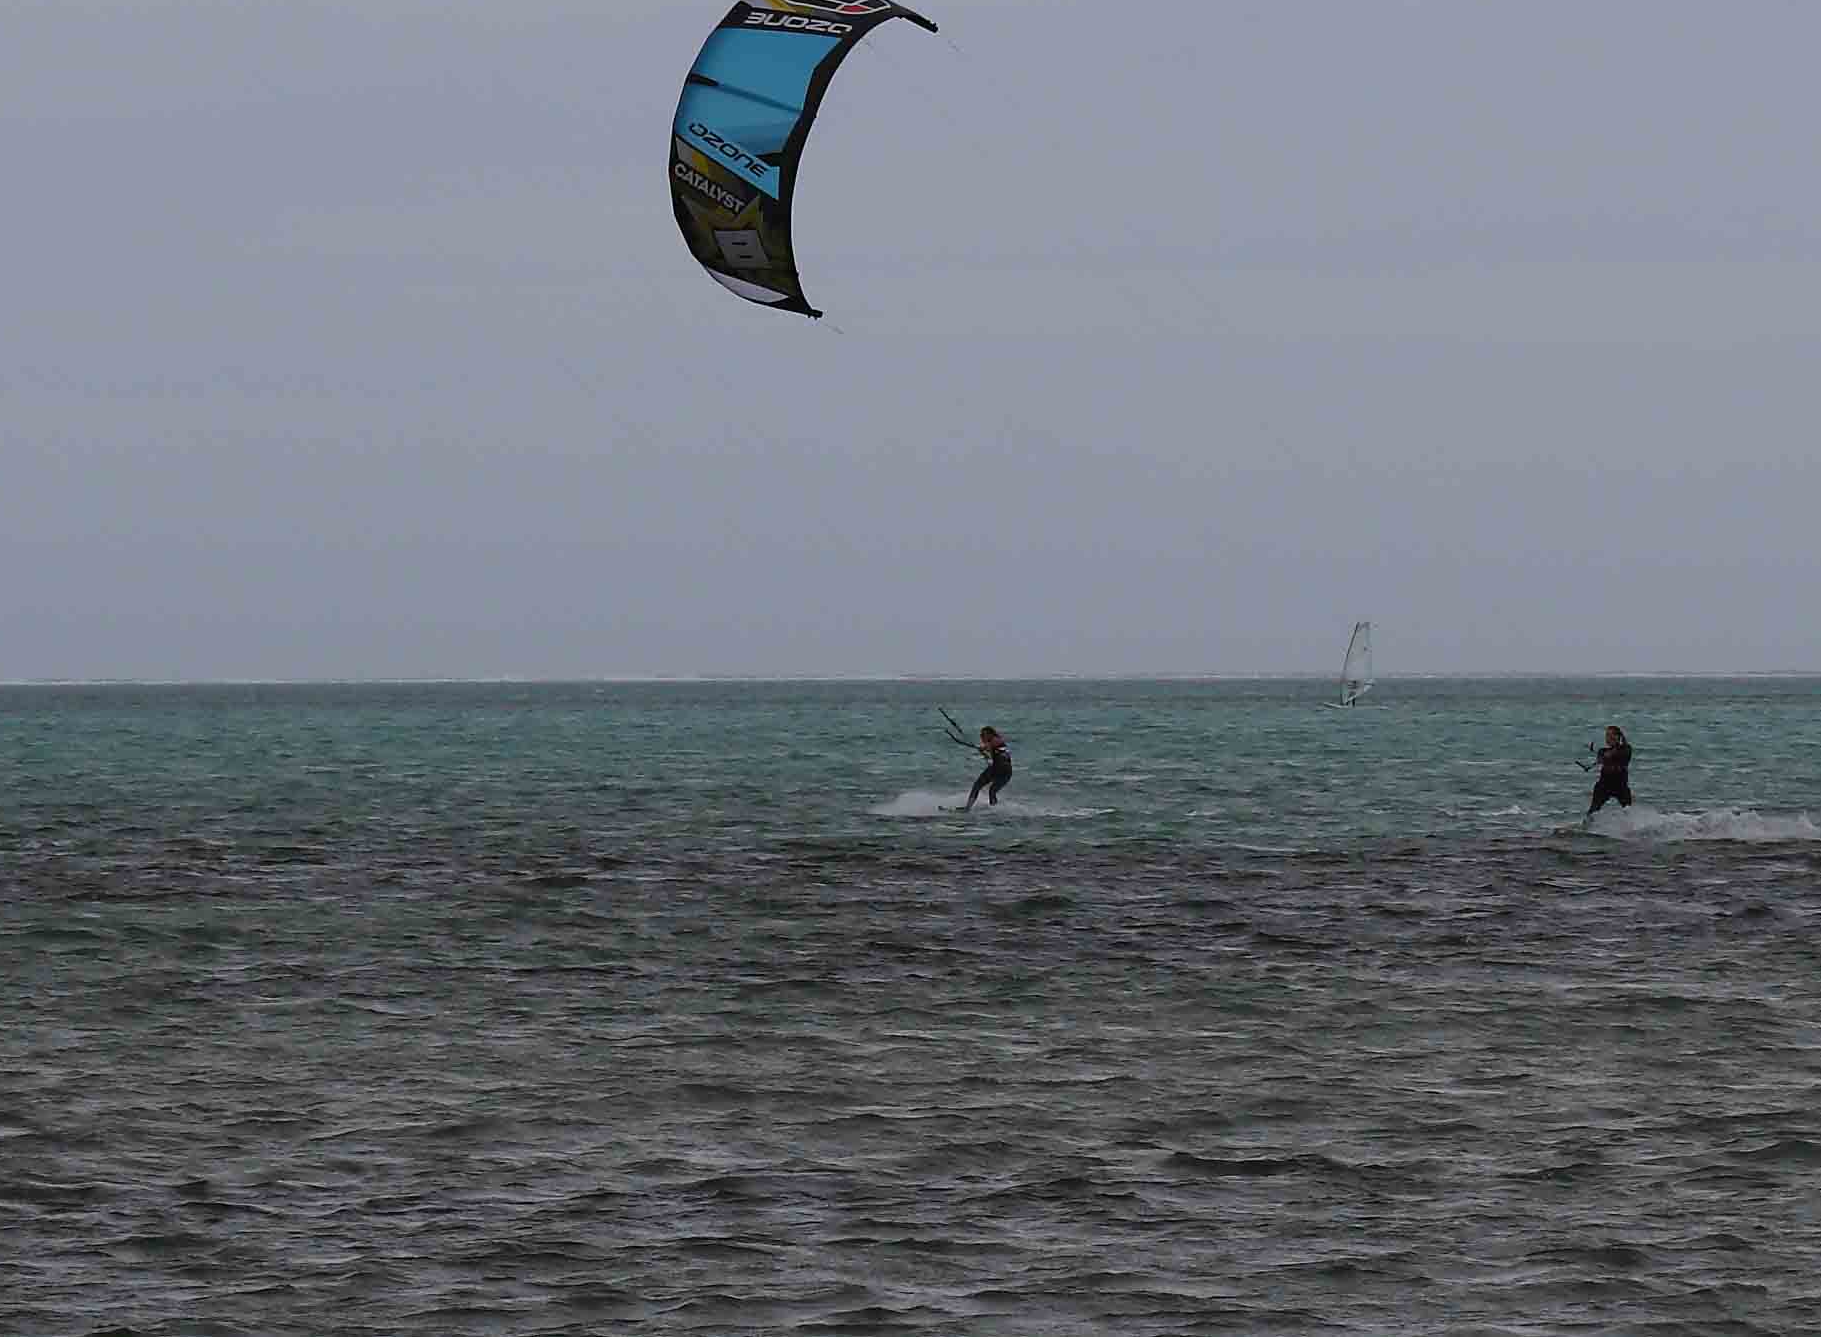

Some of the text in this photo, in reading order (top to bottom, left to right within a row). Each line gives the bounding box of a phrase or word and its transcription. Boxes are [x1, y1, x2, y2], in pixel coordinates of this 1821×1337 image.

[743, 11, 853, 34] OZONE
[689, 122, 768, 178] OZONE
[674, 162, 746, 214] CATALYST
